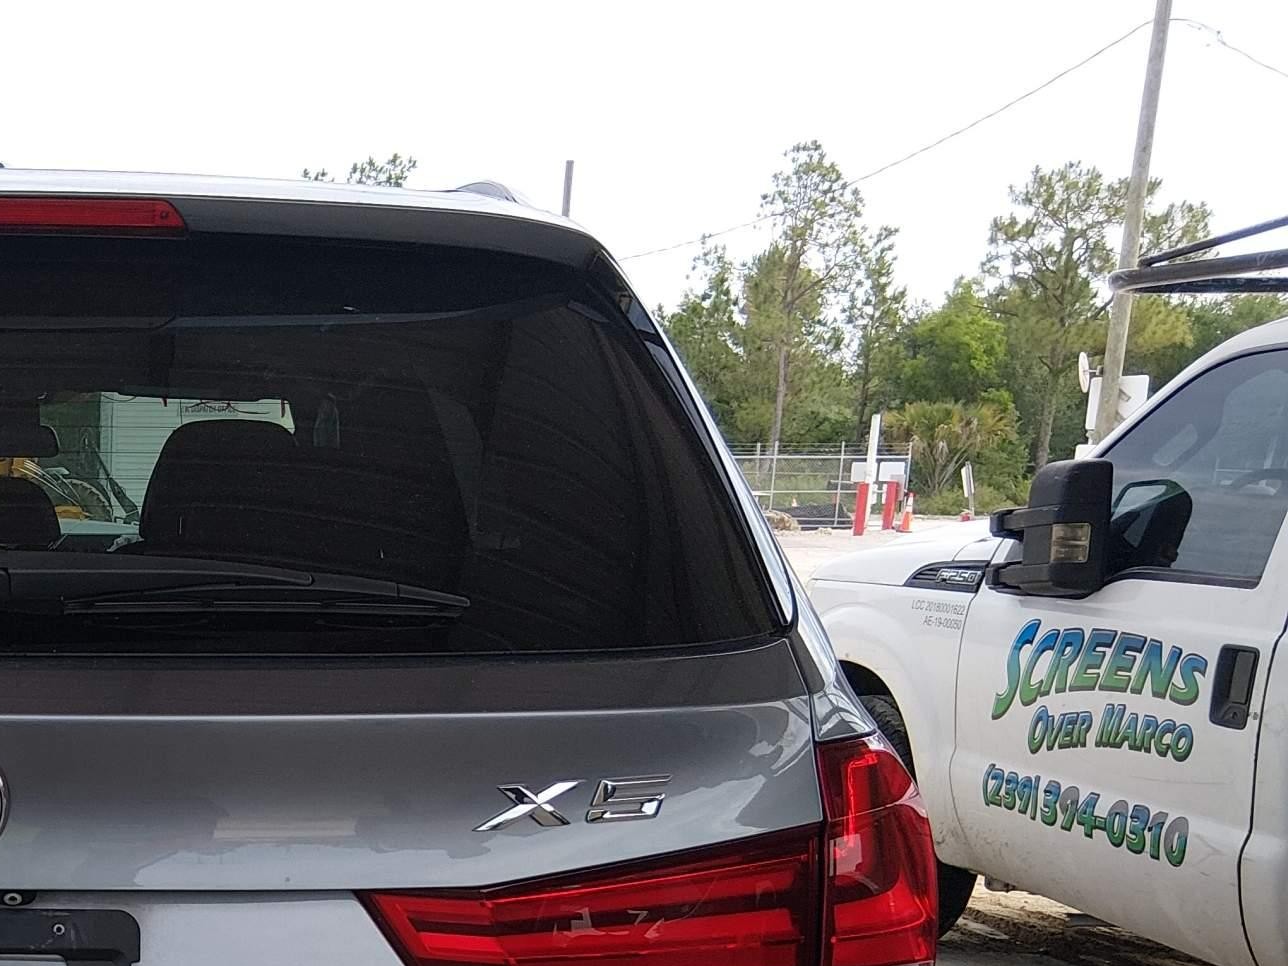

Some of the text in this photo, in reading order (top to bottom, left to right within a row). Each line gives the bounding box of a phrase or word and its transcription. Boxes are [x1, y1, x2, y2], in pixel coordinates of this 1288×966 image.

[991, 618, 1208, 720] SCREENS
[1028, 703, 1194, 762] OVER MARCO
[472, 773, 673, 832] X5
[1040, 780, 1190, 868] 394-0310
